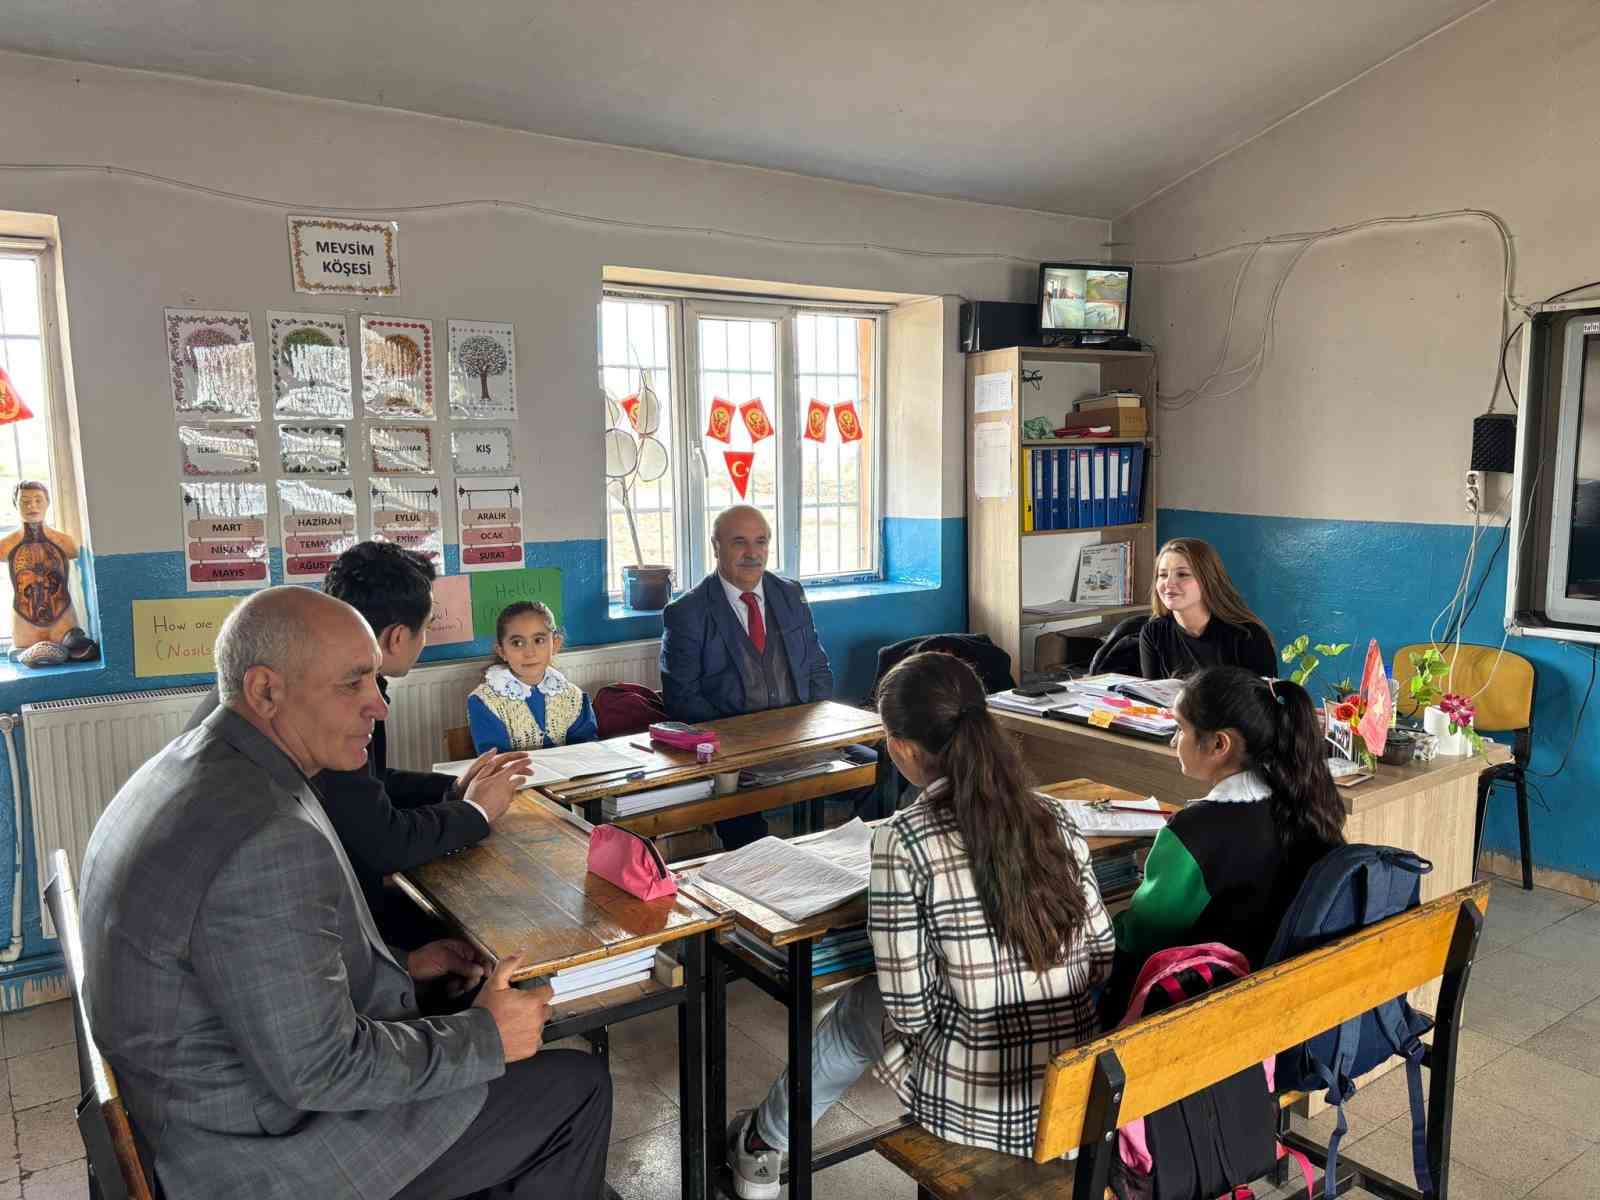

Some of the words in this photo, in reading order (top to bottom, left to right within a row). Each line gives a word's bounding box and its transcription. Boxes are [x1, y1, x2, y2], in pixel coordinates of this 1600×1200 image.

[315, 241, 374, 256] MEVSİM
[322, 259, 372, 277] KÖŞESİ
[476, 444, 492, 455] KIŞ
[477, 512, 507, 520] ARALIK
[297, 517, 342, 527] HAZİRAN
[212, 523, 242, 532] MART
[480, 532, 504, 540] OCAK
[212, 568, 247, 577] MAYIS
[495, 575, 543, 600] Hello!
[153, 615, 186, 634] How
